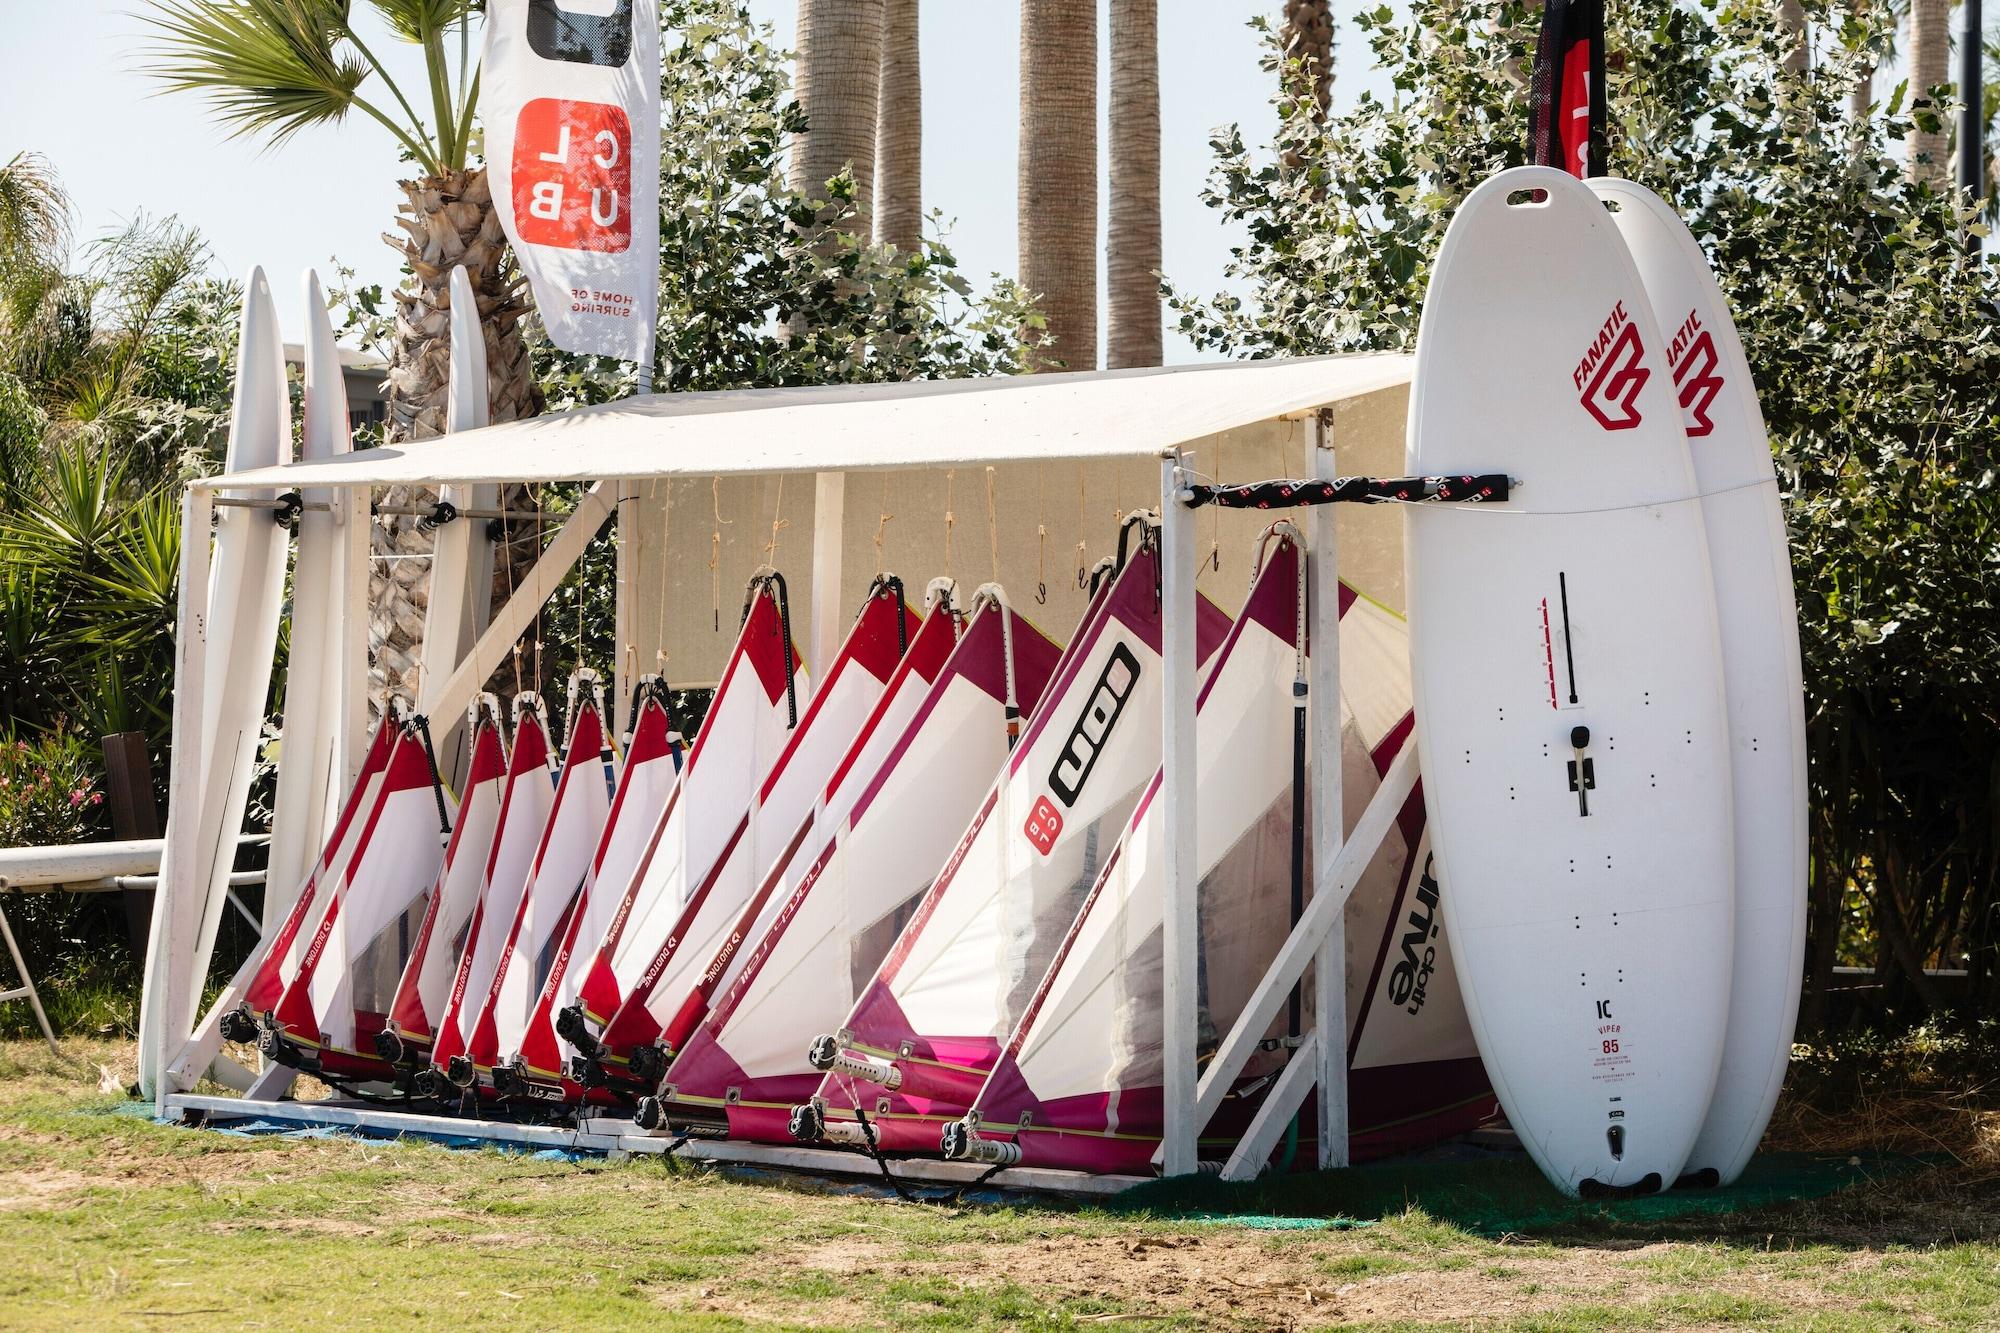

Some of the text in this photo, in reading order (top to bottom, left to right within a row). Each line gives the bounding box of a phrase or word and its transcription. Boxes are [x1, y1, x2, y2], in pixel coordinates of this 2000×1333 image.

[1573, 299, 1628, 391] FANATIC
[305, 933, 326, 968] DUOTONE
[643, 949, 670, 988] DUOTONE
[706, 944, 733, 983] DUOTONE
[454, 967, 469, 1005] DUOTONE
[1407, 946, 1436, 1016] cloth
[1596, 1000, 1612, 1019] IC
[1598, 1024, 1621, 1034] VIPER
[1602, 1039, 1619, 1053] 85
